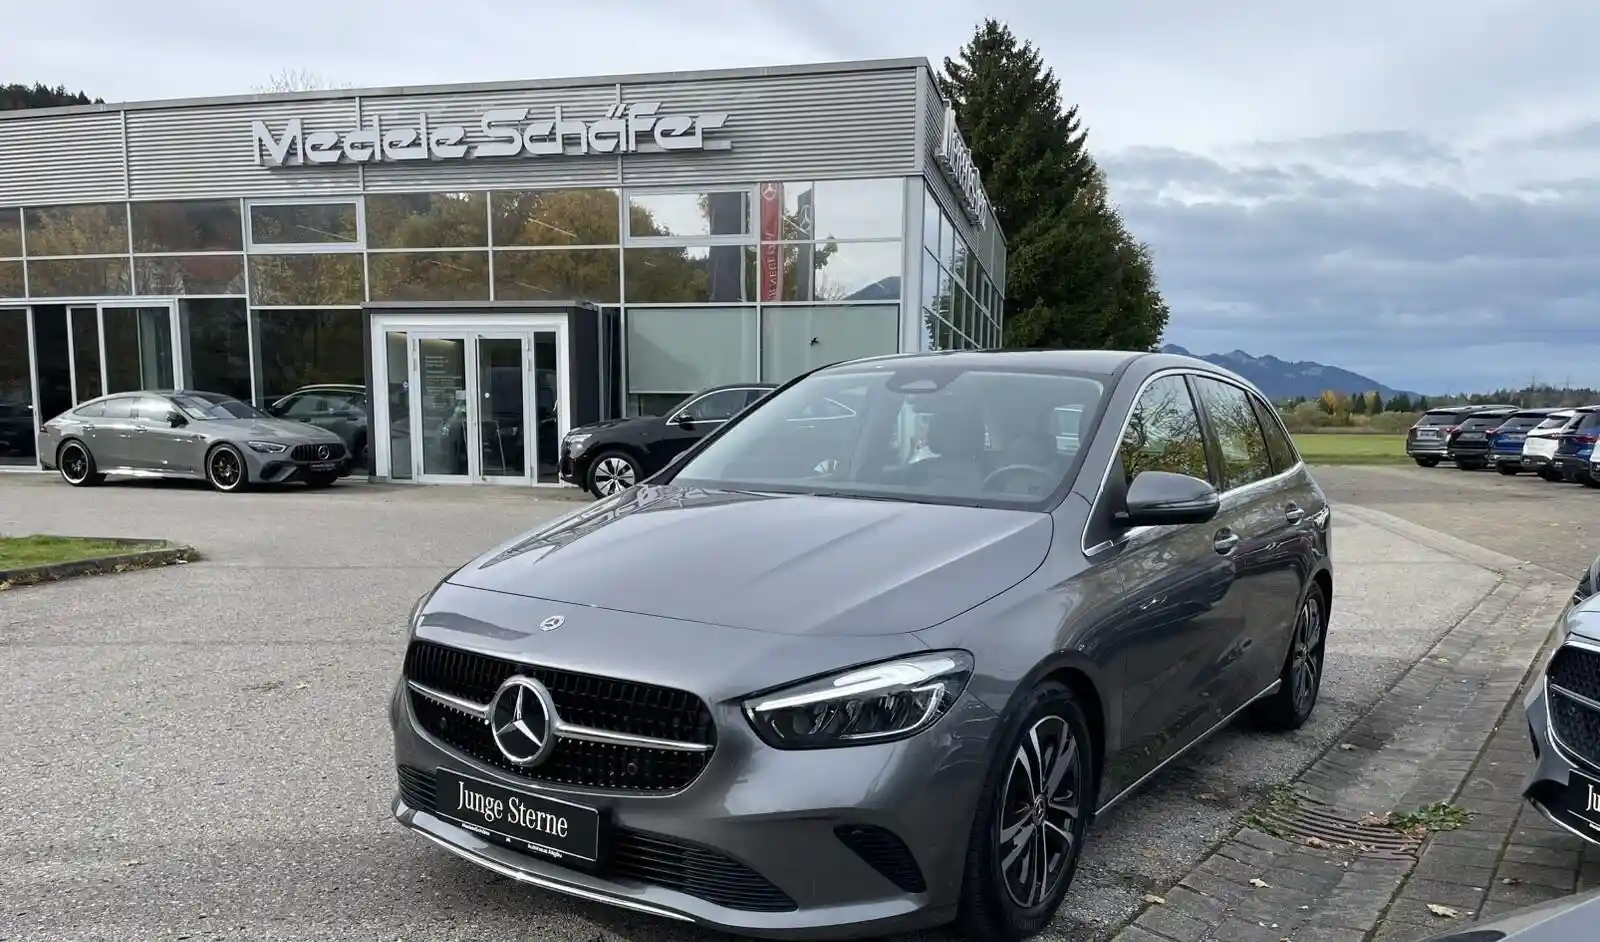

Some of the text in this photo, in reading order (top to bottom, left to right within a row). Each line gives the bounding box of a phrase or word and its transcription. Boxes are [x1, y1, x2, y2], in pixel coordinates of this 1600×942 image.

[251, 102, 731, 166] Medele Schäfer
[456, 781, 568, 838] Junge Sterne
